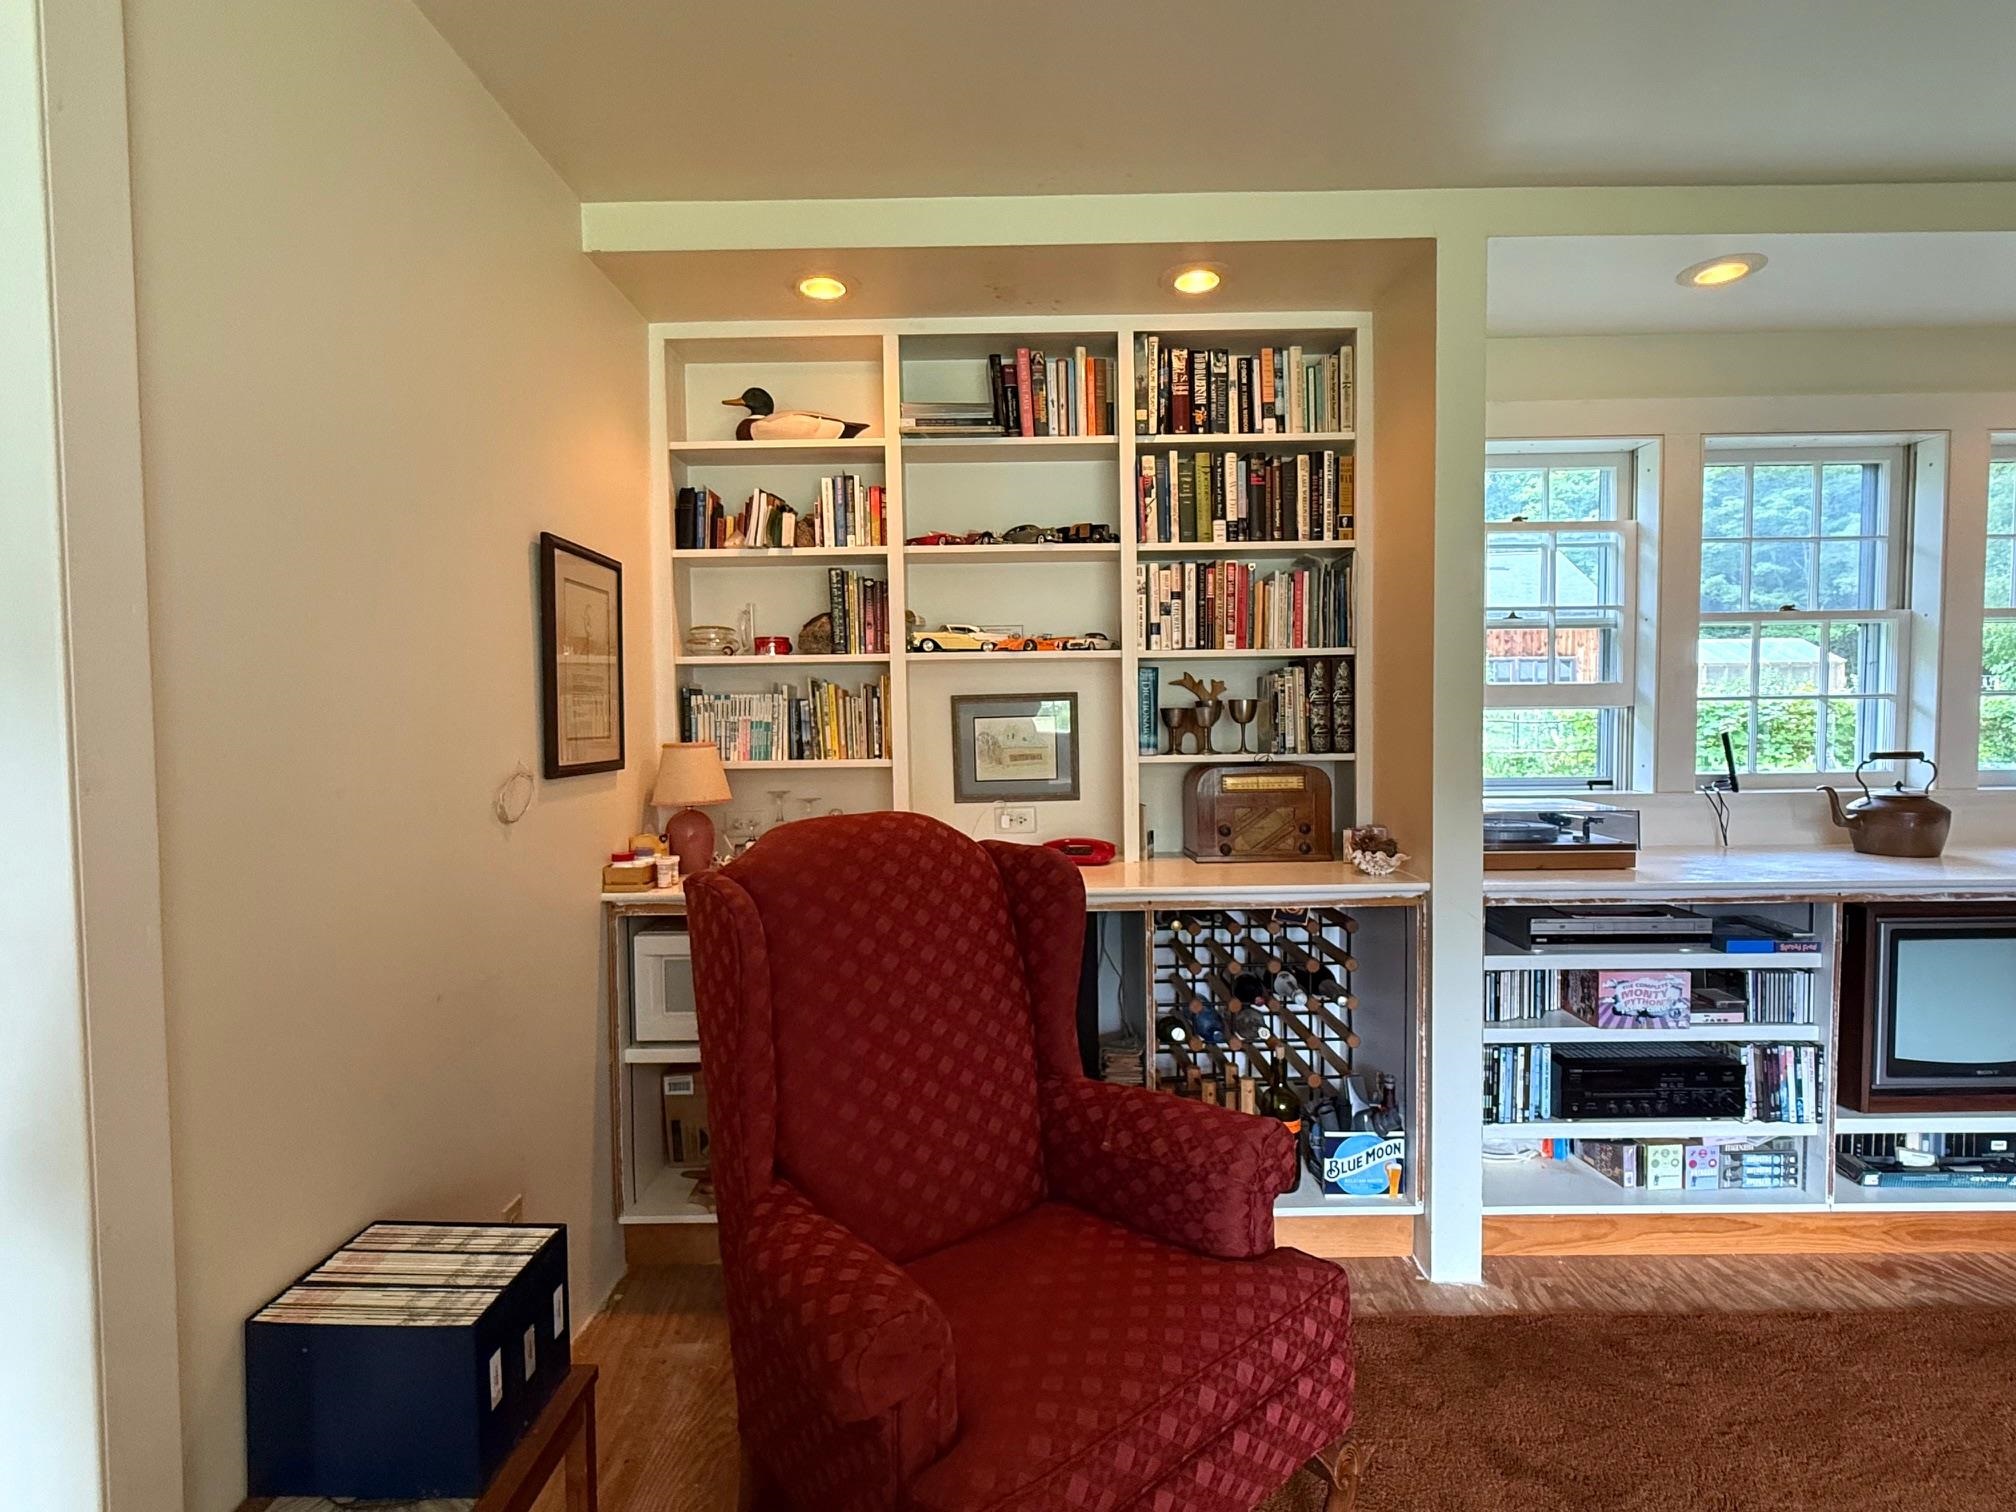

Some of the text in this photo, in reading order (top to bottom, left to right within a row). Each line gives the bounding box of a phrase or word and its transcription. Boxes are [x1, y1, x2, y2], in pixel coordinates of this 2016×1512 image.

[1217, 377, 1228, 424] LINDBERGH
[1228, 456, 1236, 477] How
[1229, 480, 1237, 494] We
[1229, 498, 1237, 516] Die
[1142, 681, 1152, 739] DICTIONARY
[1621, 988, 1668, 999] MONTY
[1635, 982, 1669, 990] COMPLETE
[1623, 998, 1665, 1007] PYTHON
[1326, 1142, 1402, 1179] BLUE MOON
